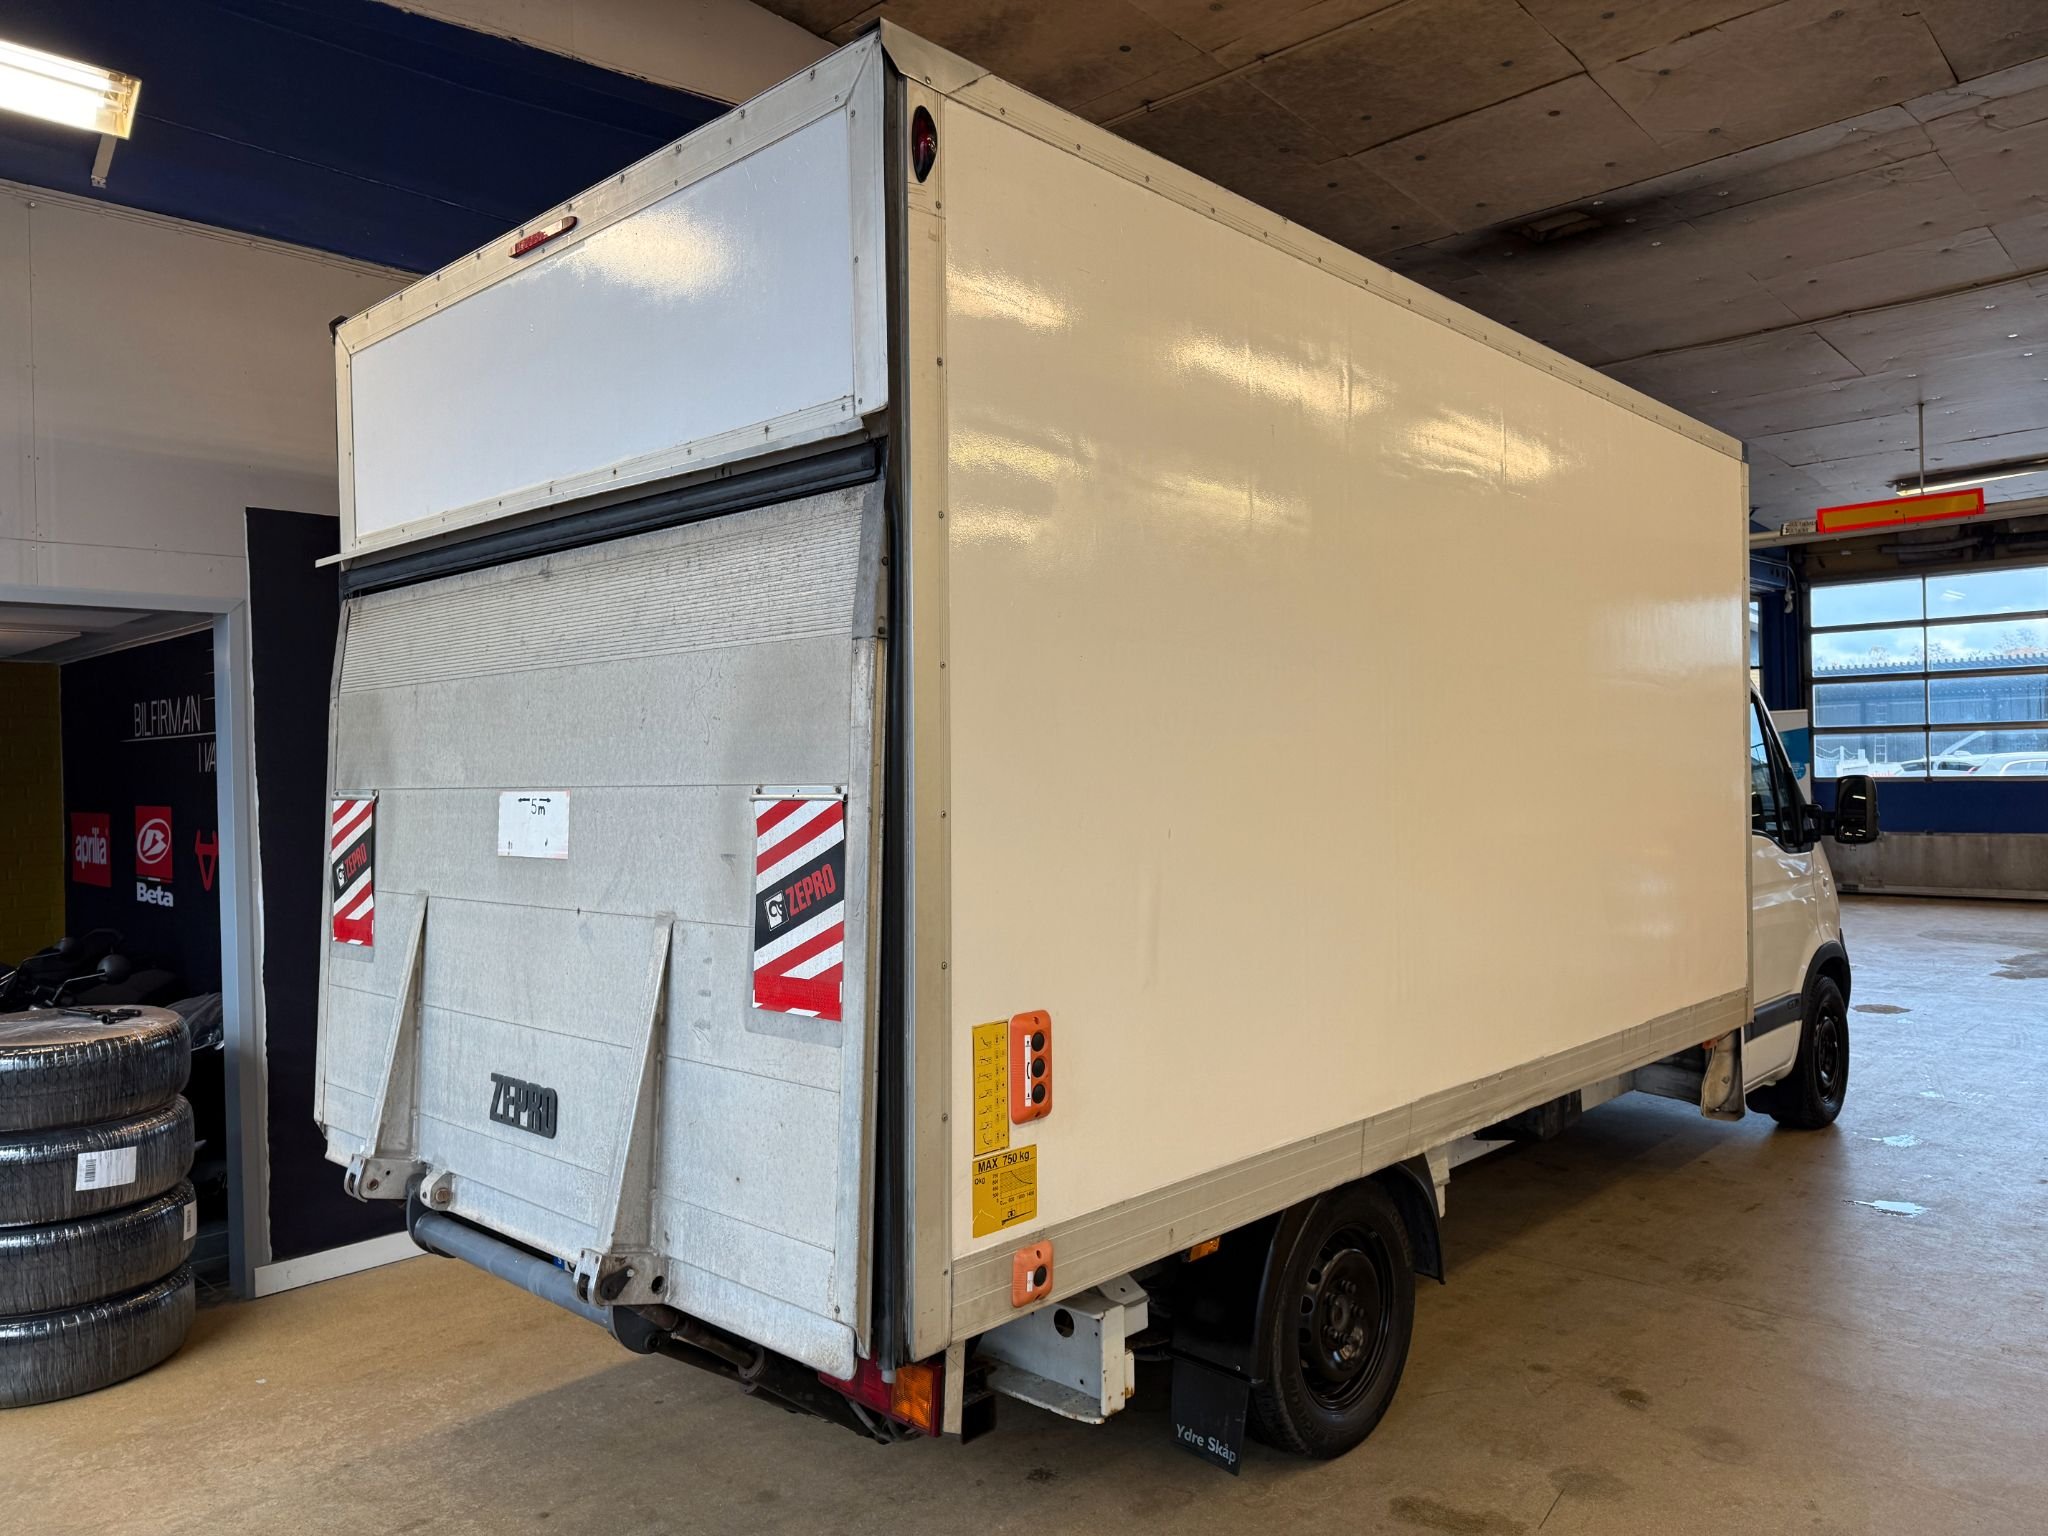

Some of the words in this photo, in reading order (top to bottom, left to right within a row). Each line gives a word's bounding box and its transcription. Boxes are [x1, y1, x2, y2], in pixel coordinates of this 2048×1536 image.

[133, 694, 201, 738] BILFIRMAN
[74, 827, 107, 869] aprilia
[344, 842, 368, 879] ZEPRO
[136, 881, 174, 907] Beta
[785, 863, 836, 917] ZEPRO
[489, 1072, 558, 1139] ZEPRO
[978, 1157, 998, 1173] MAX
[1002, 1153, 1017, 1166] 750
[1019, 1151, 1030, 1162] kg
[1176, 1423, 1205, 1447] Ydre
